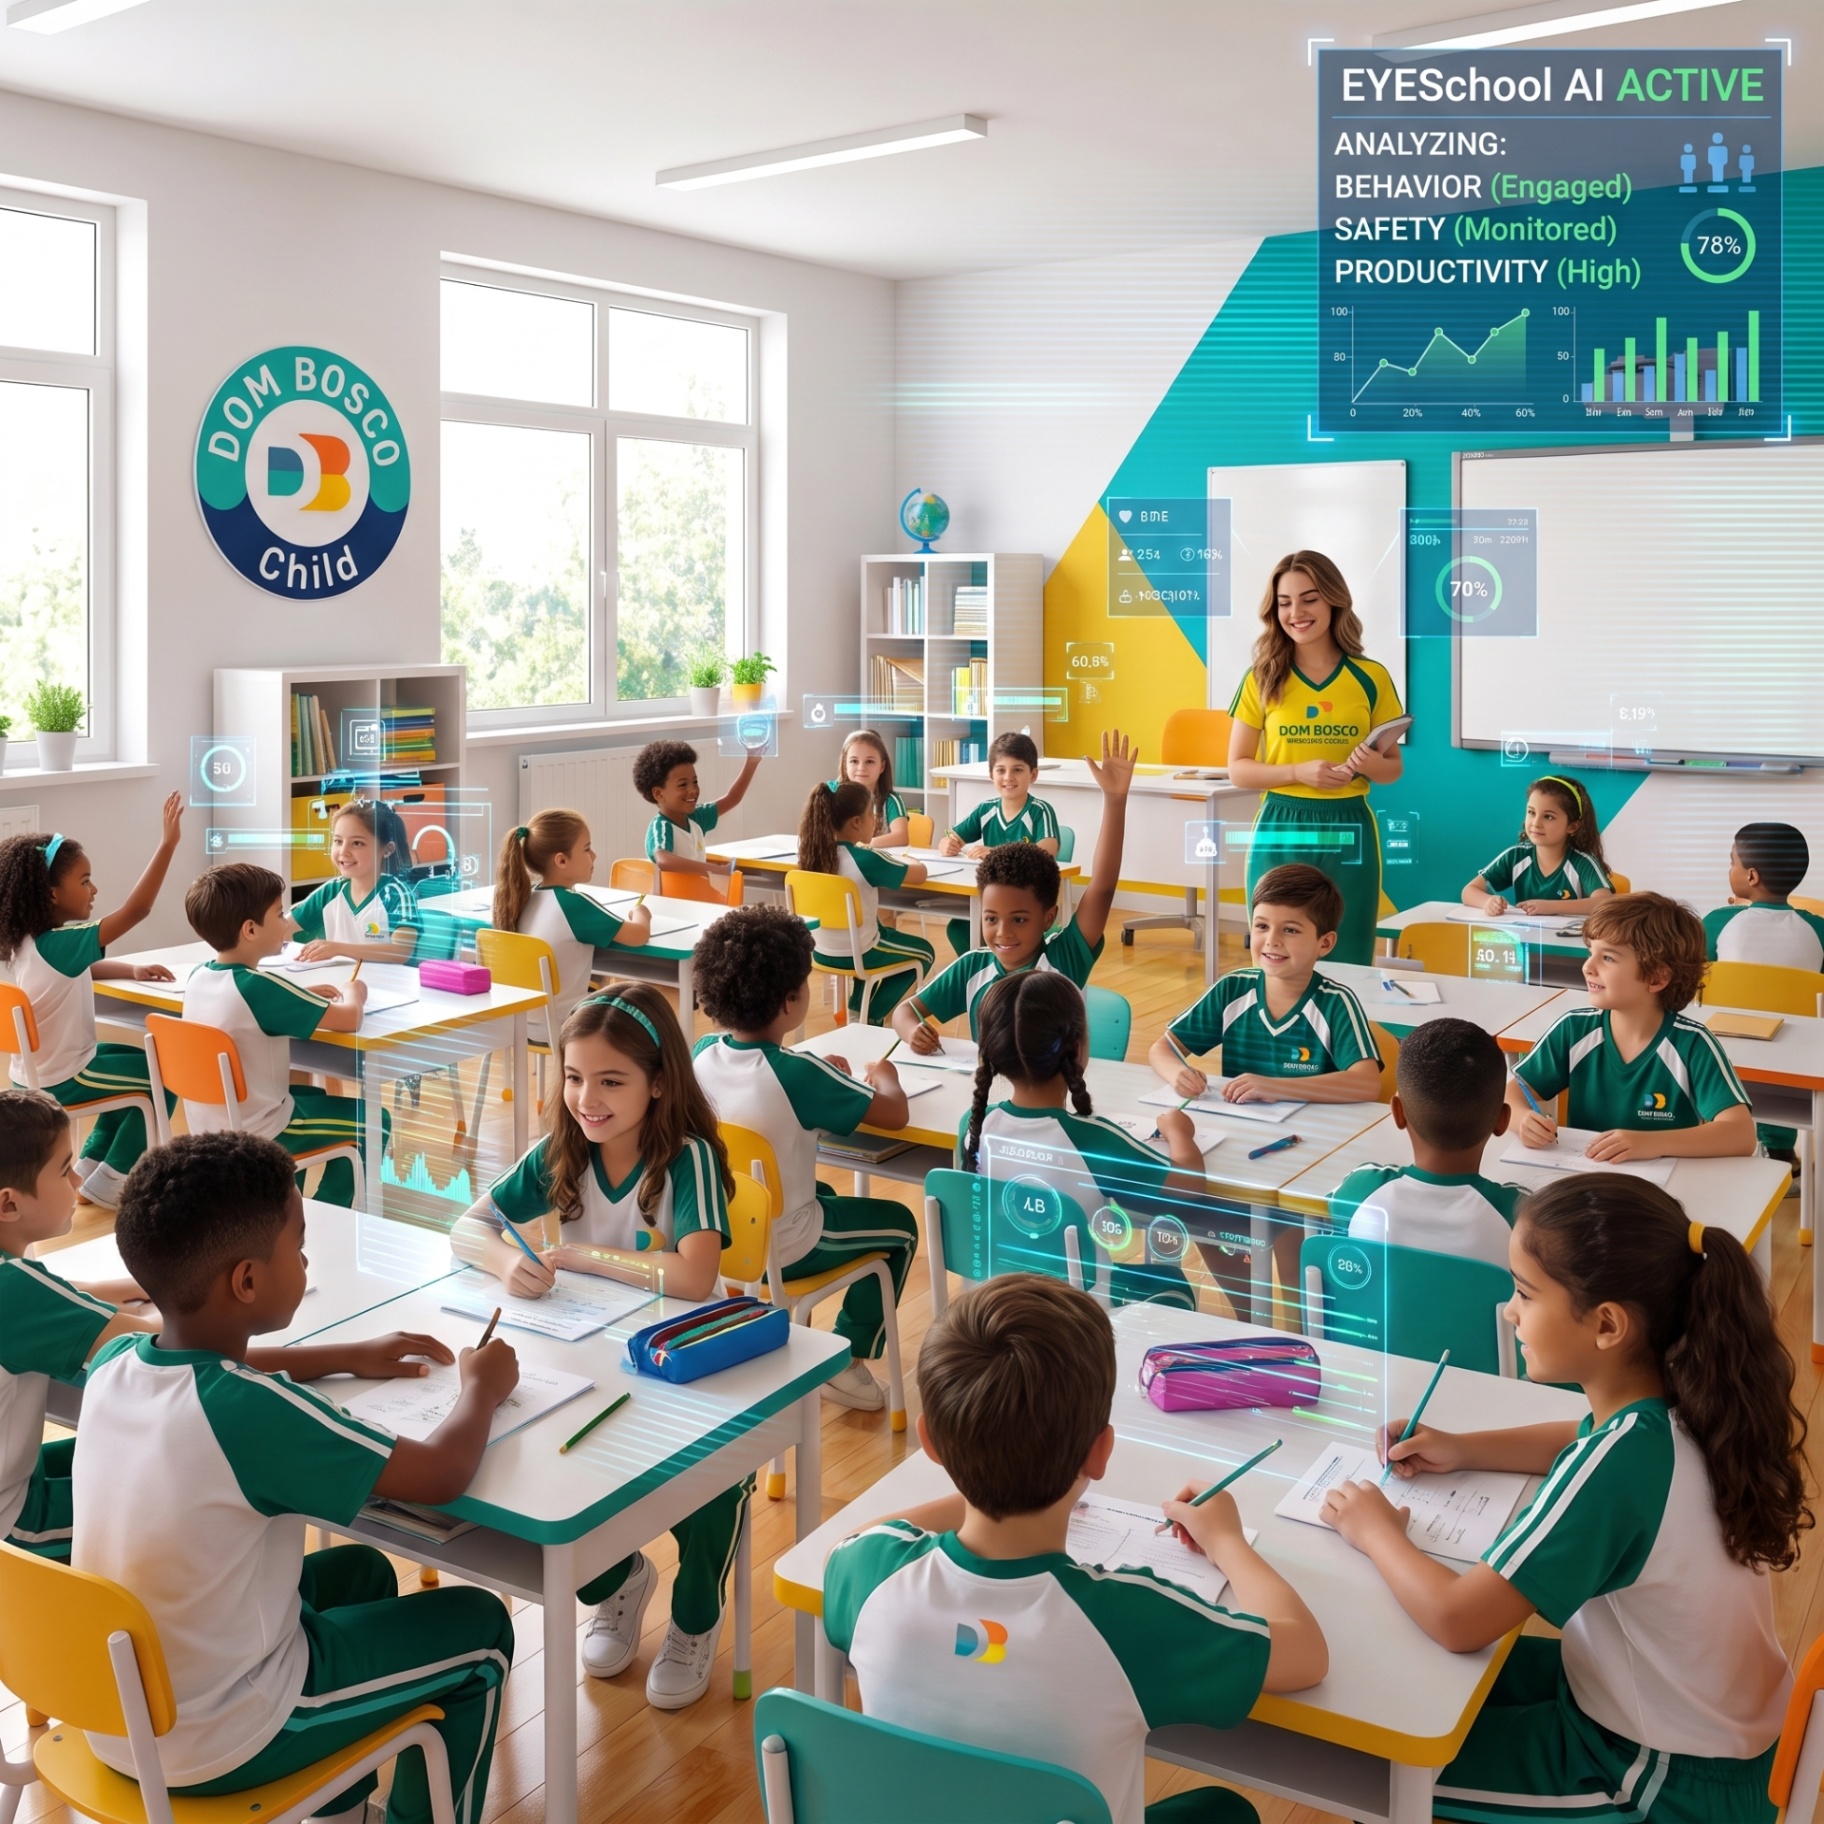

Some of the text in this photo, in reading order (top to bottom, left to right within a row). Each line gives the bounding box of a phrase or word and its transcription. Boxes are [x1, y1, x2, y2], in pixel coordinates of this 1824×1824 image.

[208, 357, 400, 466] DOM BOSCO
[259, 545, 358, 590] Child
[1279, 725, 1359, 737] DOM BOSCO
